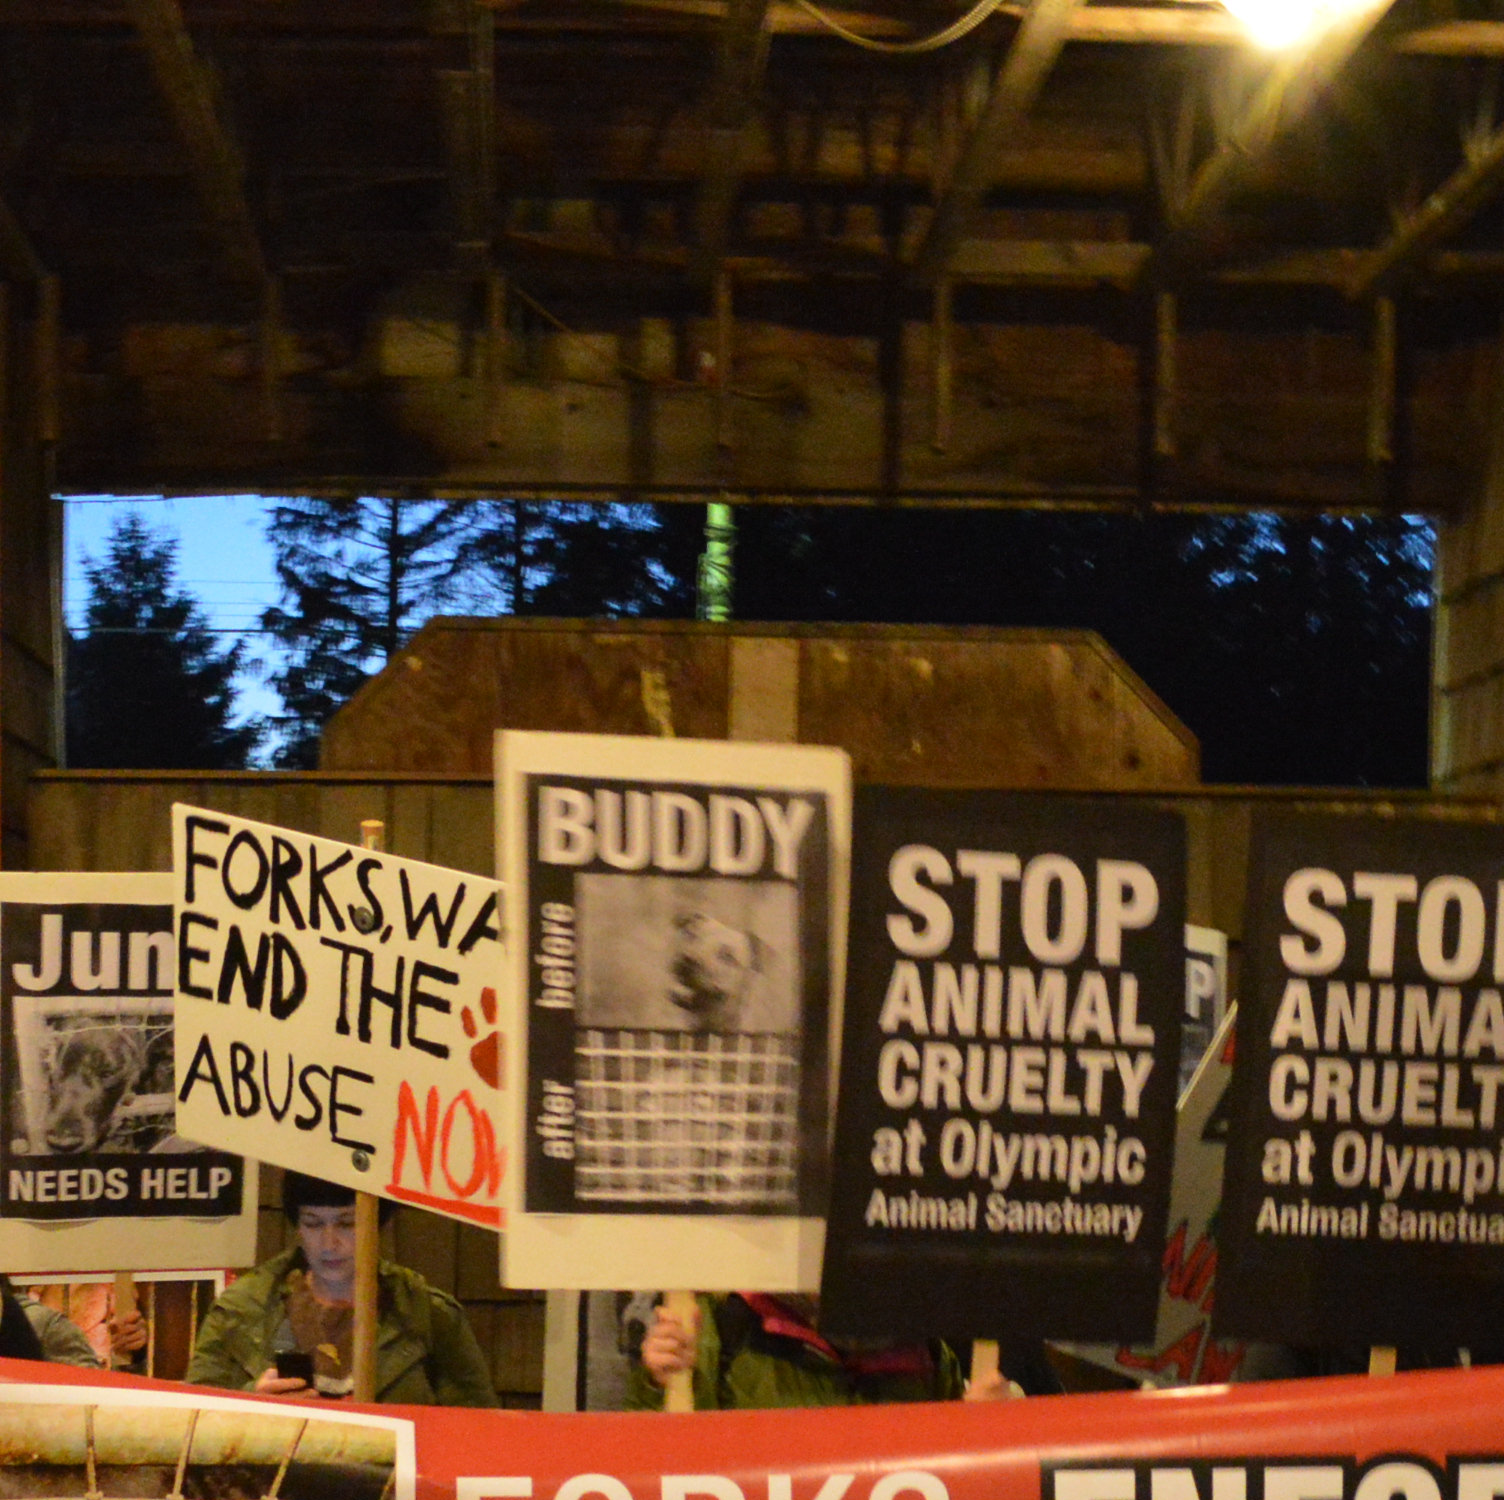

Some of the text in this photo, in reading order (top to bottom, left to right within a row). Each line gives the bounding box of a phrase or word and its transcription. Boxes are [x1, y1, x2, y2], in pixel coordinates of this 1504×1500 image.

[537, 785, 814, 880] BUDDY
[185, 815, 393, 943] FORKS,
[886, 845, 1159, 966] STOP
[12, 914, 175, 991] Jun
[178, 912, 458, 1059] END THE
[535, 902, 575, 1008] before
[880, 958, 1154, 1045] ANIMAL
[178, 1034, 375, 1155] ABUSE
[535, 1079, 575, 1159] after
[878, 1042, 1155, 1117] CRUELTY
[8, 1168, 232, 1201] NEEDS HELP
[870, 1117, 1145, 1194] at Olympic
[1262, 1130, 1314, 1185] at
[865, 1189, 1142, 1241] Animal Sanctuary
[1256, 1197, 1369, 1237] Animal
